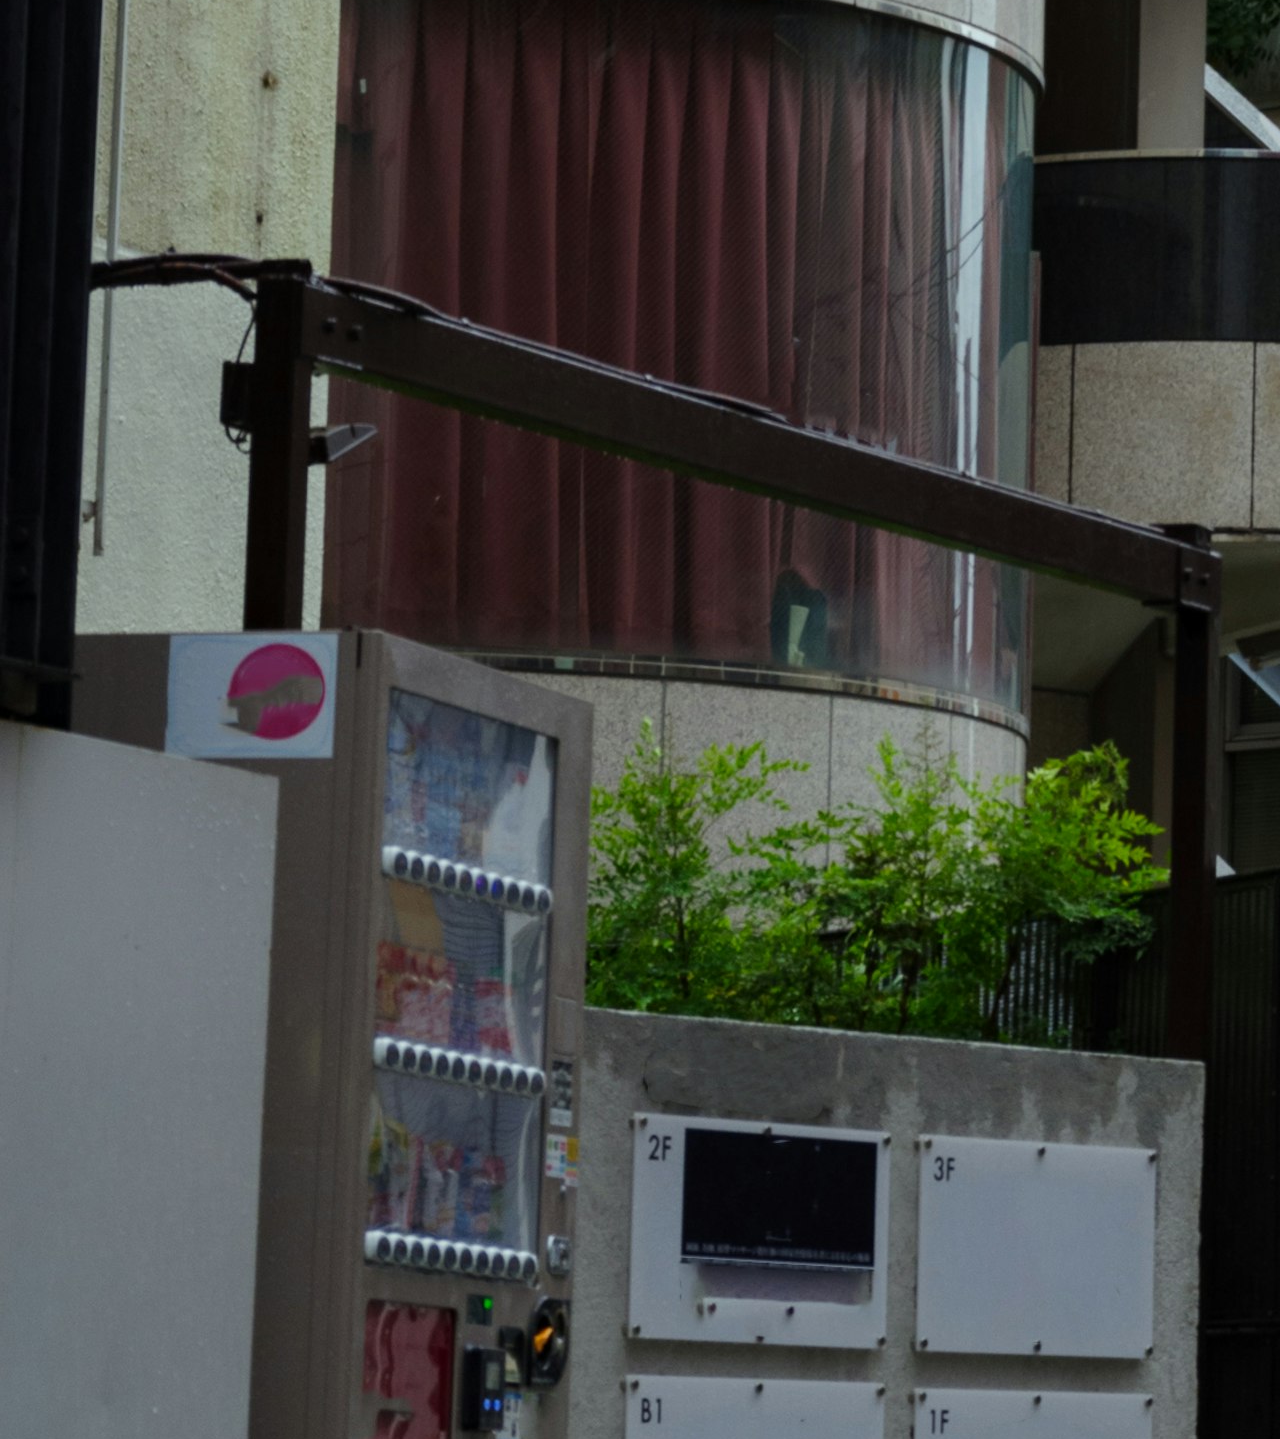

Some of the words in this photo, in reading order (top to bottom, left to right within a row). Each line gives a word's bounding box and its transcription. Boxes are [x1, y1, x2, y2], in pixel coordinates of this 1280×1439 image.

[648, 1135, 672, 1161] 2F
[933, 1157, 956, 1181] 3F
[640, 1398, 663, 1425] B1
[929, 1409, 950, 1435] 1F
